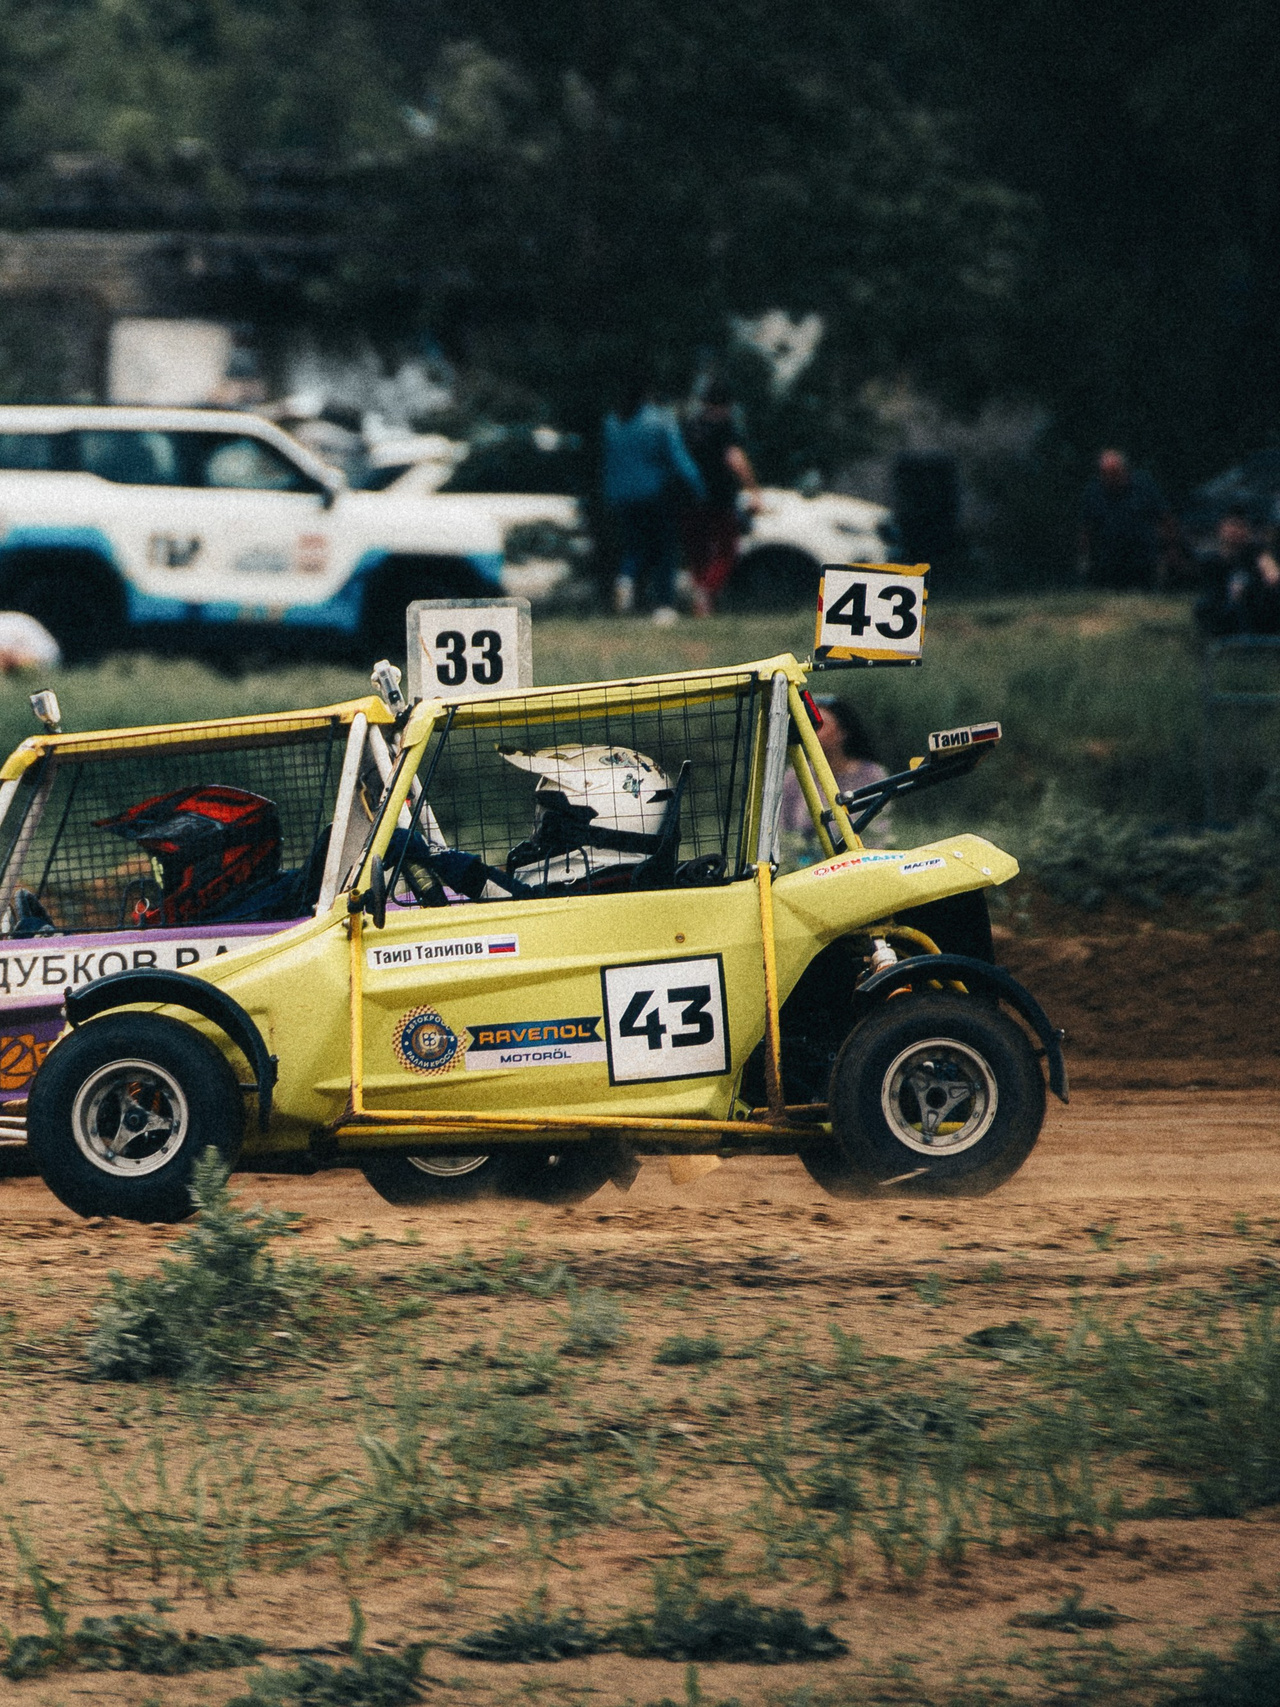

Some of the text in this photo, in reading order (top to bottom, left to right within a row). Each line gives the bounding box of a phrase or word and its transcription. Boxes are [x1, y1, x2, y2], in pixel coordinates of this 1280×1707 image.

[825, 582, 919, 640] 43
[435, 629, 504, 687] 33
[932, 730, 971, 749] Таир
[373, 942, 483, 965] Таир Талипов
[619, 984, 715, 1050] 43
[479, 1024, 591, 1045] RAVENOL
[500, 1048, 572, 1063] MOTORÖL
